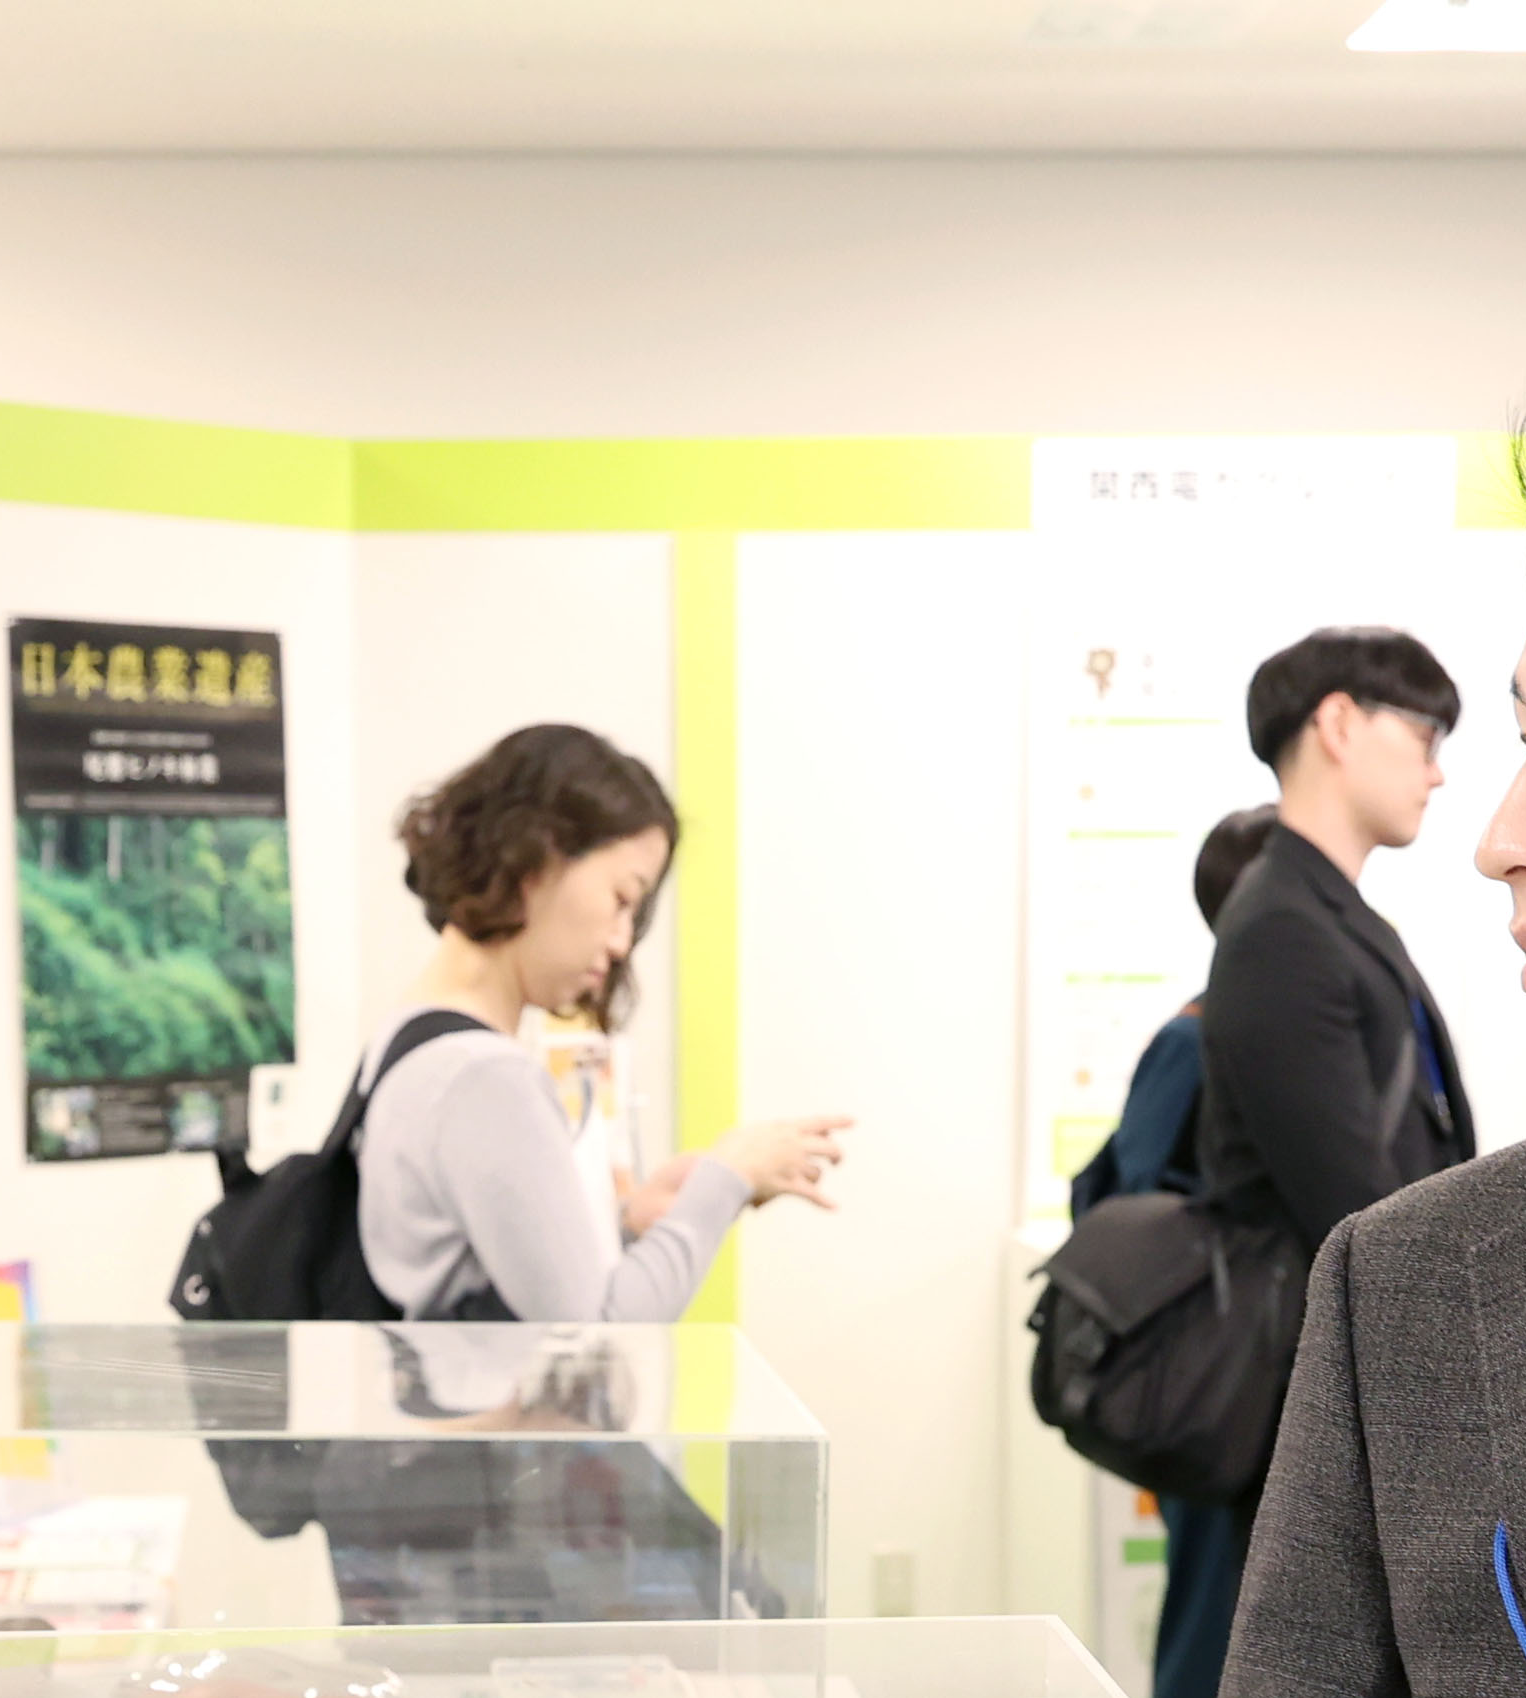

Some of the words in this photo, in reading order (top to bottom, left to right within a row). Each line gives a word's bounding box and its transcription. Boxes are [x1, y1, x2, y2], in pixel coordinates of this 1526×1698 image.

[21, 642, 276, 708] 日本農業遺産
